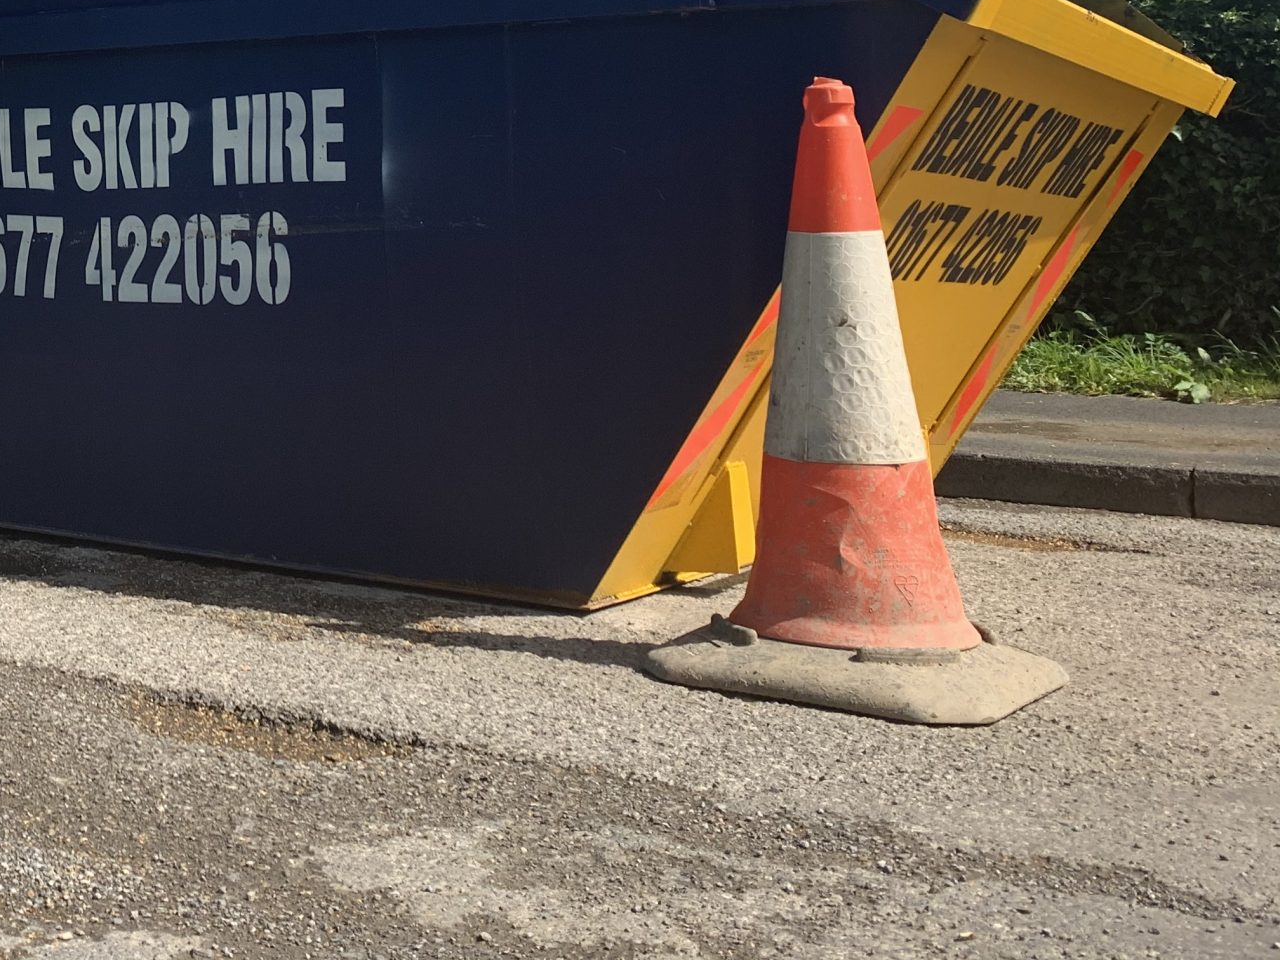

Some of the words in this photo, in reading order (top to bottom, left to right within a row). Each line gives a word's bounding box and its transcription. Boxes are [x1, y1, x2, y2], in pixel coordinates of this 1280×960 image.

[71, 101, 191, 192] SKIP
[211, 88, 347, 187] HIRE
[911, 84, 1040, 182] BEDALE
[996, 107, 1081, 189] SKIP
[1040, 121, 1124, 198] HIRE
[85, 211, 292, 305] 422056
[885, 199, 972, 281] 01677
[938, 208, 1043, 286] 422056
